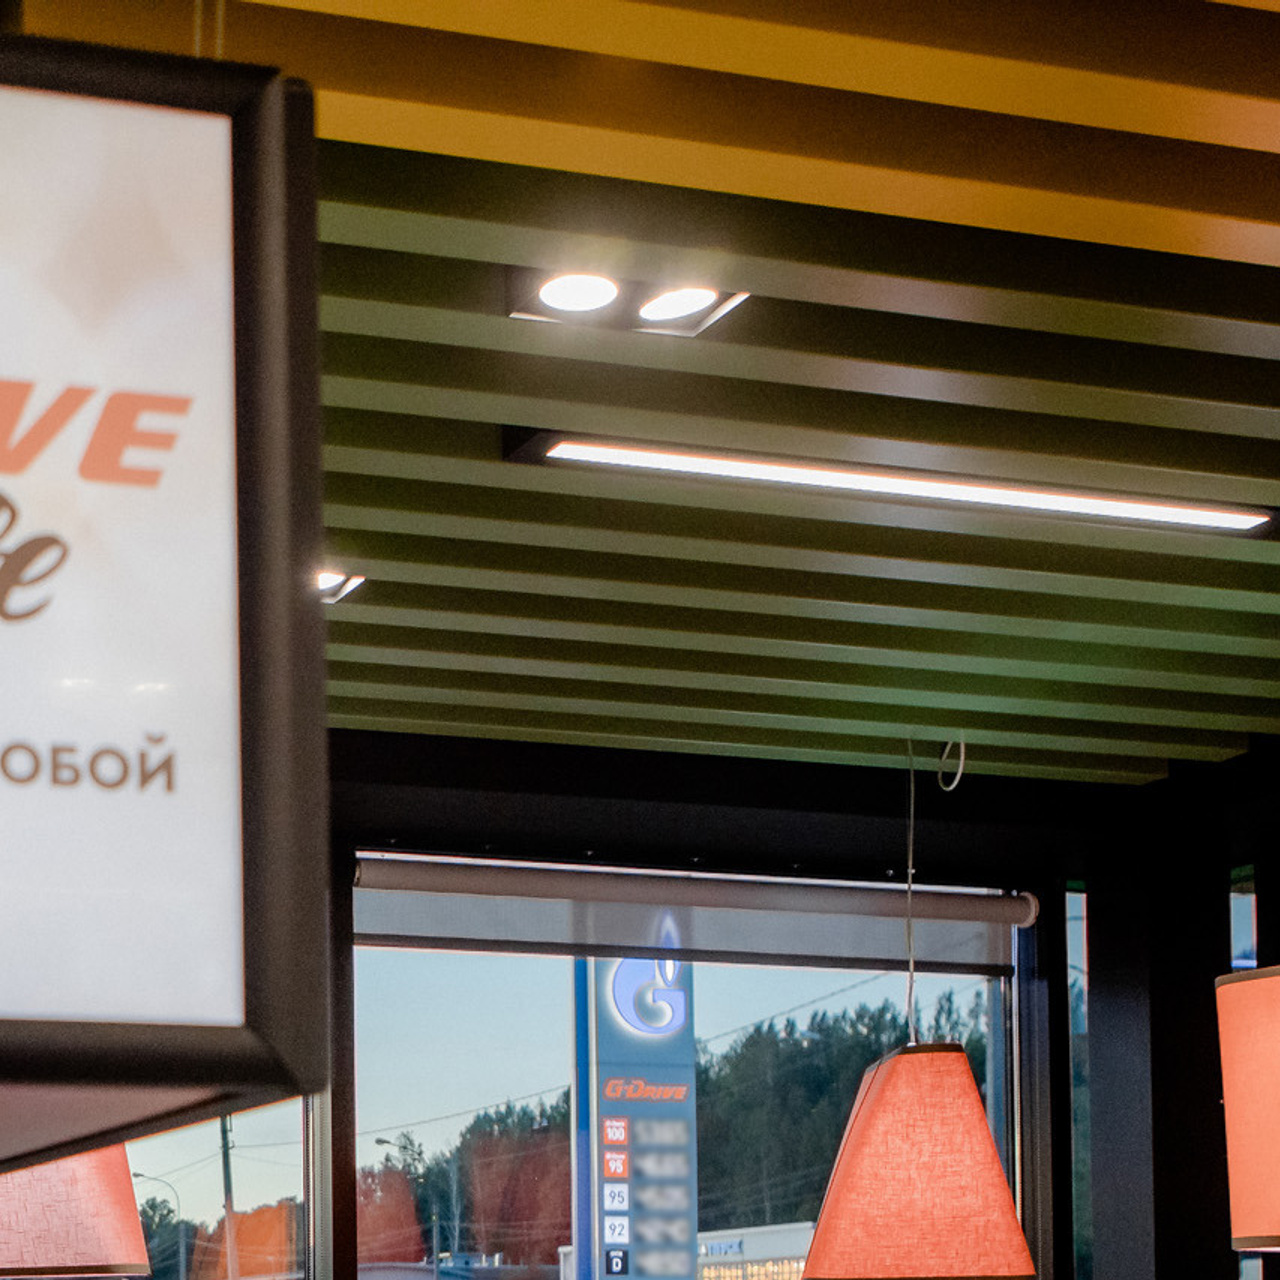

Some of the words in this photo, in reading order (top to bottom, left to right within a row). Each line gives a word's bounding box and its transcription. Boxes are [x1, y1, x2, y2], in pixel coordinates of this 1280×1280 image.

[606, 1127, 625, 1141] 100
[608, 1160, 624, 1174] 95
[609, 1190, 624, 1204] 95
[609, 1223, 625, 1237] 92
